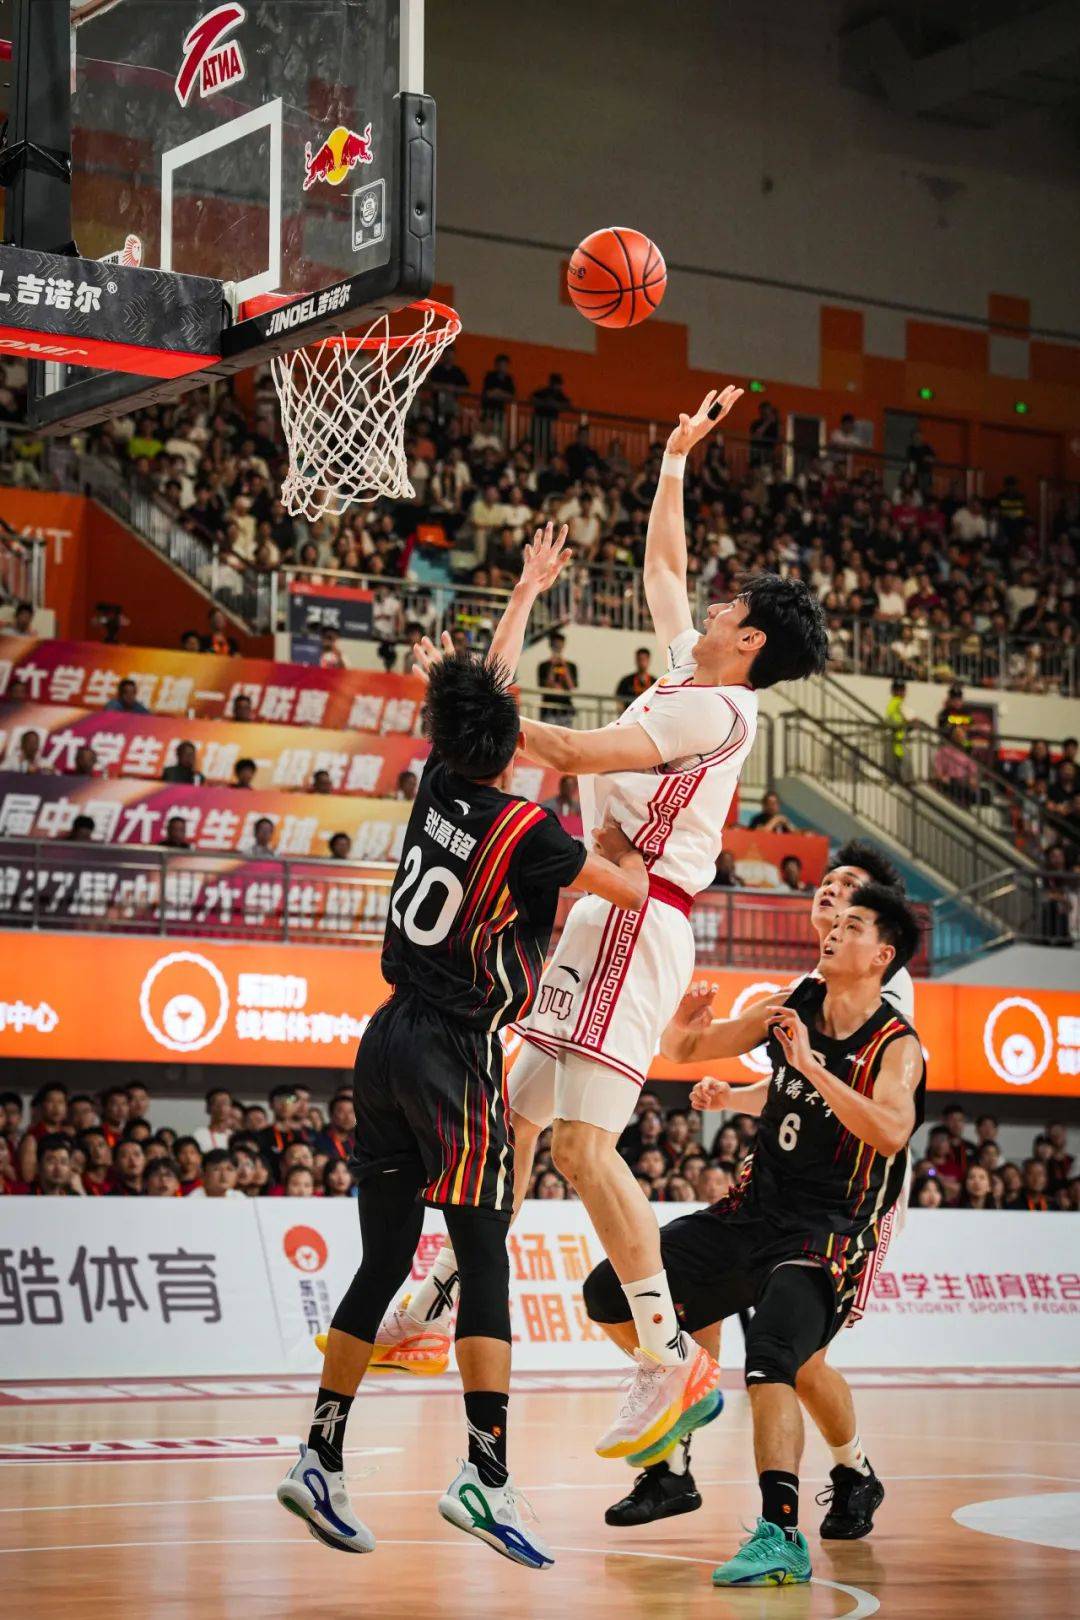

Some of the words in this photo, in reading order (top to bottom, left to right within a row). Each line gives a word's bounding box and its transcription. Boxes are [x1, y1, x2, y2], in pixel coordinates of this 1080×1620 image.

[16, 273, 102, 314] 吉诺尔
[391, 844, 464, 947] 20
[0, 999, 60, 1033] 中心
[538, 984, 574, 1021] 14
[778, 1112, 801, 1151] 6
